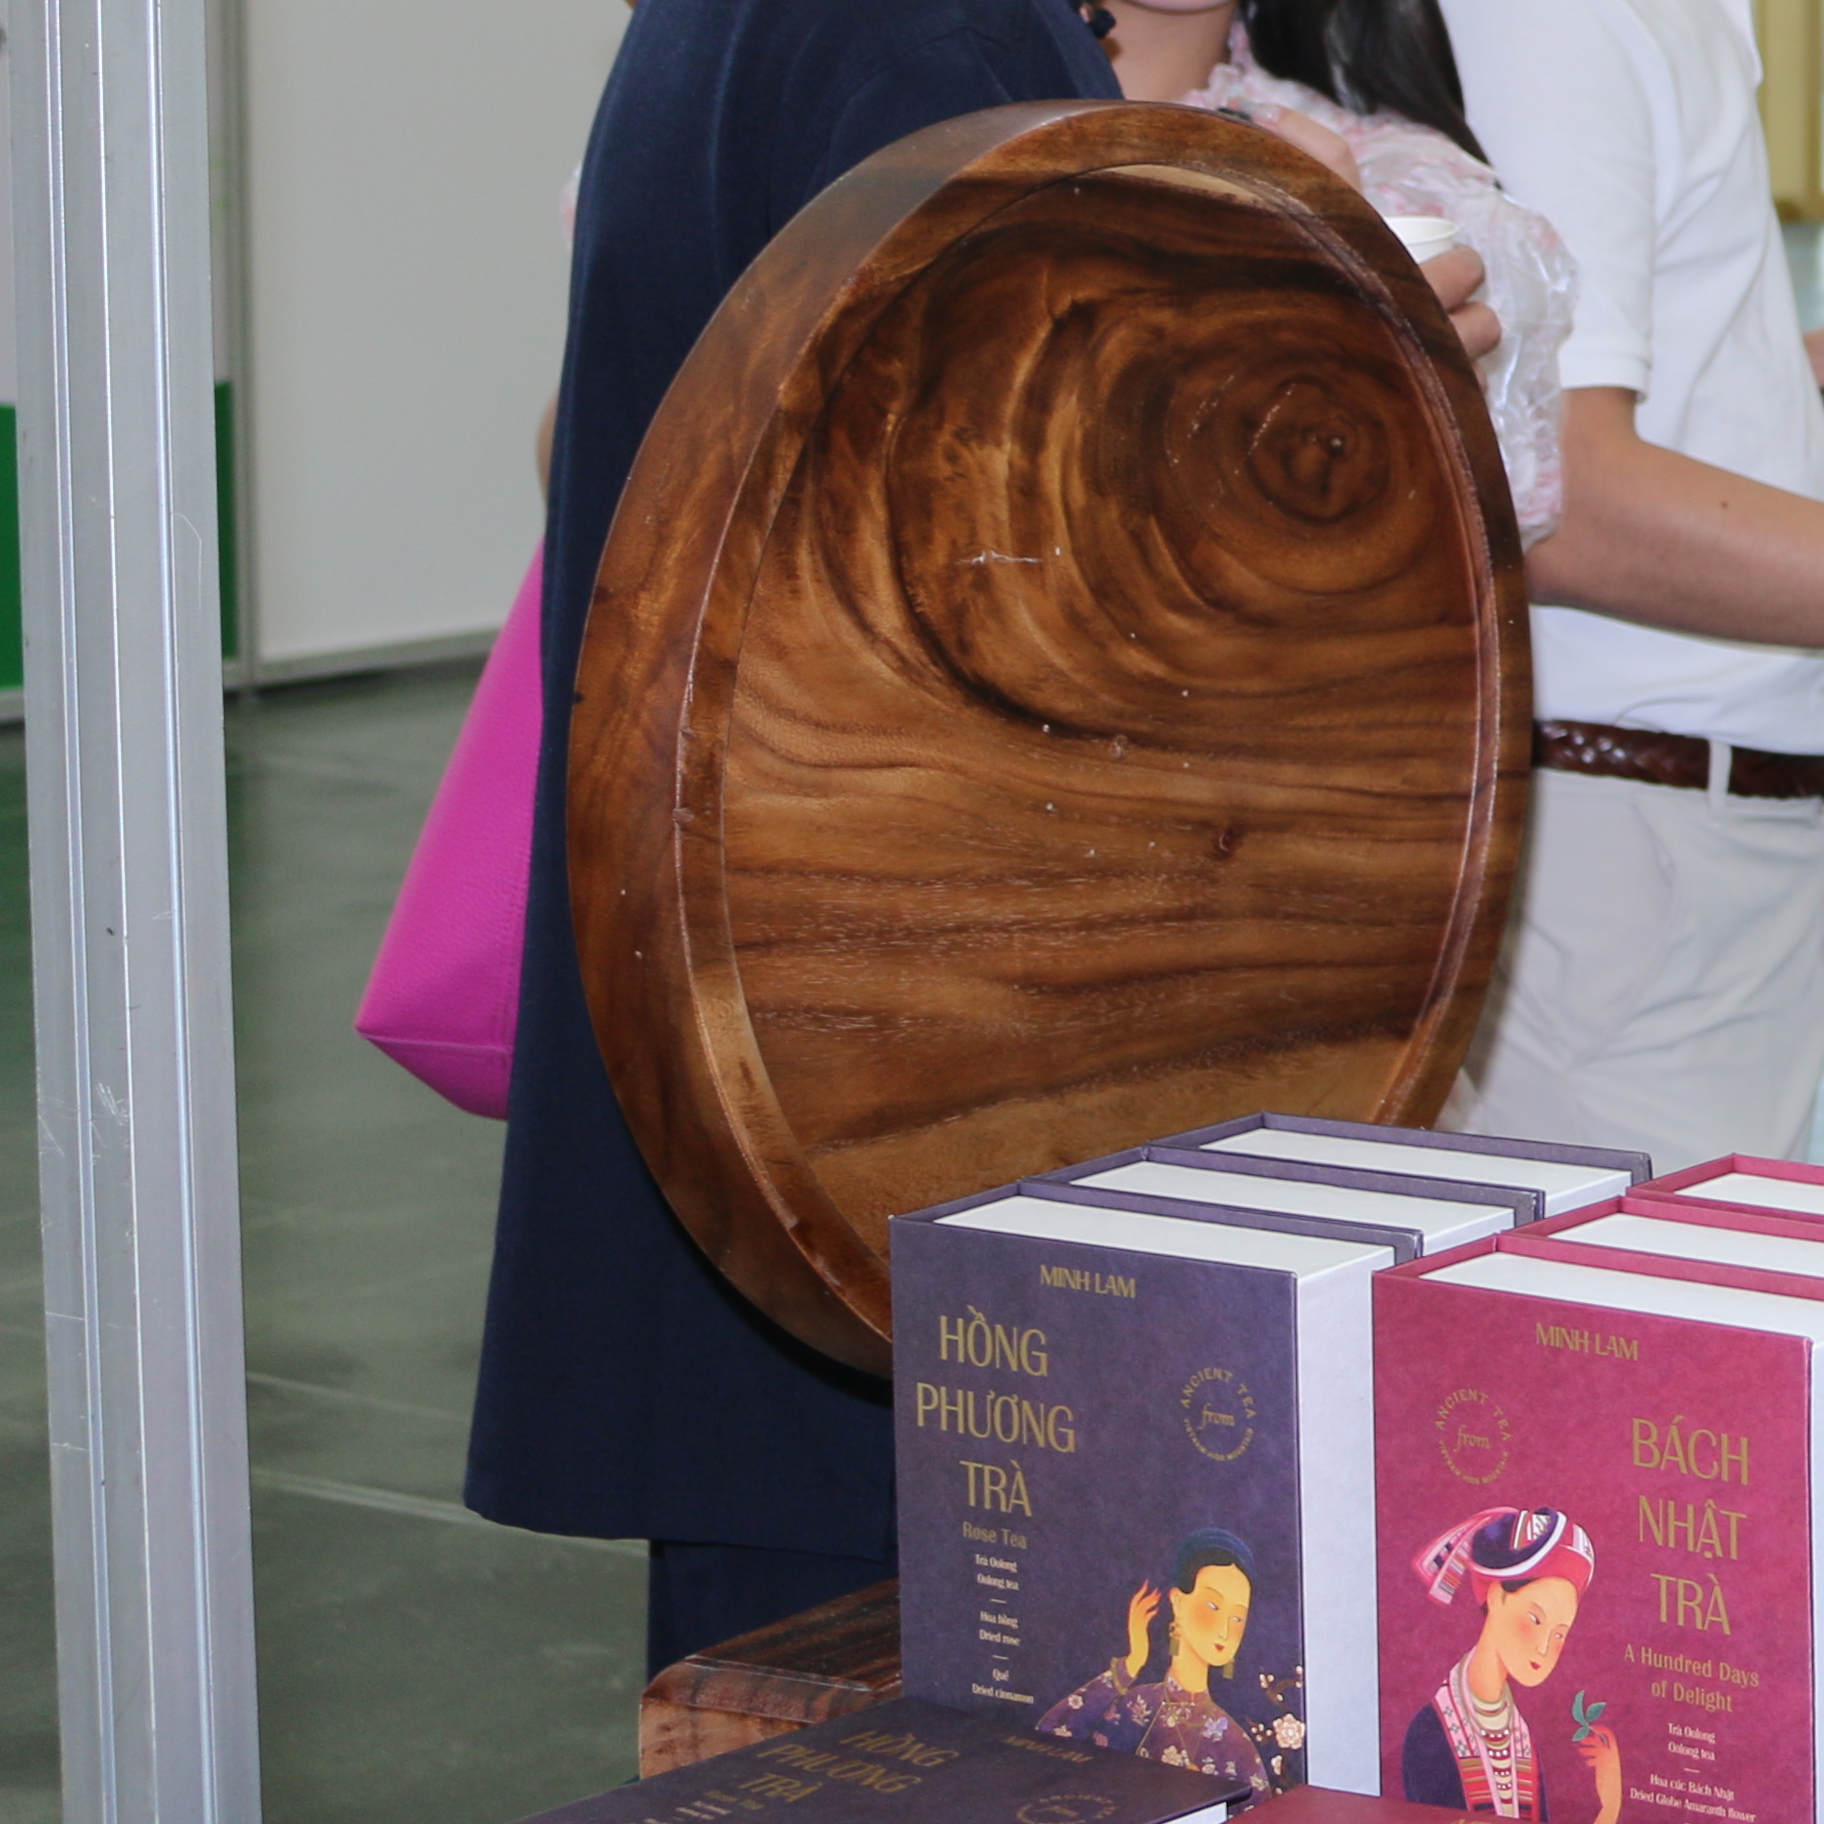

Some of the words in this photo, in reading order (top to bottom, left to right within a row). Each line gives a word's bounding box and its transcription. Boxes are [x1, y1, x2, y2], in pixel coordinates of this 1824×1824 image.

[1040, 1264, 1090, 1291] MINH
[1095, 1273, 1137, 1298] LAM
[938, 1304, 1048, 1376] HỒNG
[1535, 1323, 1589, 1354] MINH
[1595, 1332, 1639, 1361] LAM
[1181, 1367, 1234, 1409] ANCIENT
[1238, 1383, 1257, 1419] TEA
[1435, 1388, 1489, 1430] ANCIENT
[1493, 1406, 1512, 1441] TEA
[916, 1382, 1076, 1453] PHƯƠNG
[1631, 1415, 1749, 1485] BÁCH
[959, 1459, 1032, 1516] TRÀ
[962, 1521, 997, 1543] Rose
[1001, 1528, 1028, 1549] Tea
[1638, 1494, 1747, 1560] NHẬT
[1651, 1573, 1731, 1635] TRÀ
[1624, 1643, 1635, 1662] A
[1641, 1646, 1712, 1677] Hundred
[1719, 1662, 1760, 1688] Days
[1651, 1680, 1668, 1697] of
[1674, 1682, 1733, 1712] Delight
[1668, 1722, 1682, 1735] Trà
[1684, 1725, 1716, 1744] Oolong
[1668, 1741, 1699, 1760] Oolong
[1701, 1748, 1716, 1761] tea
[1630, 1787, 1654, 1803] Dried
[1656, 1792, 1682, 1808] Globe
[1728, 1806, 1757, 1823] flower
